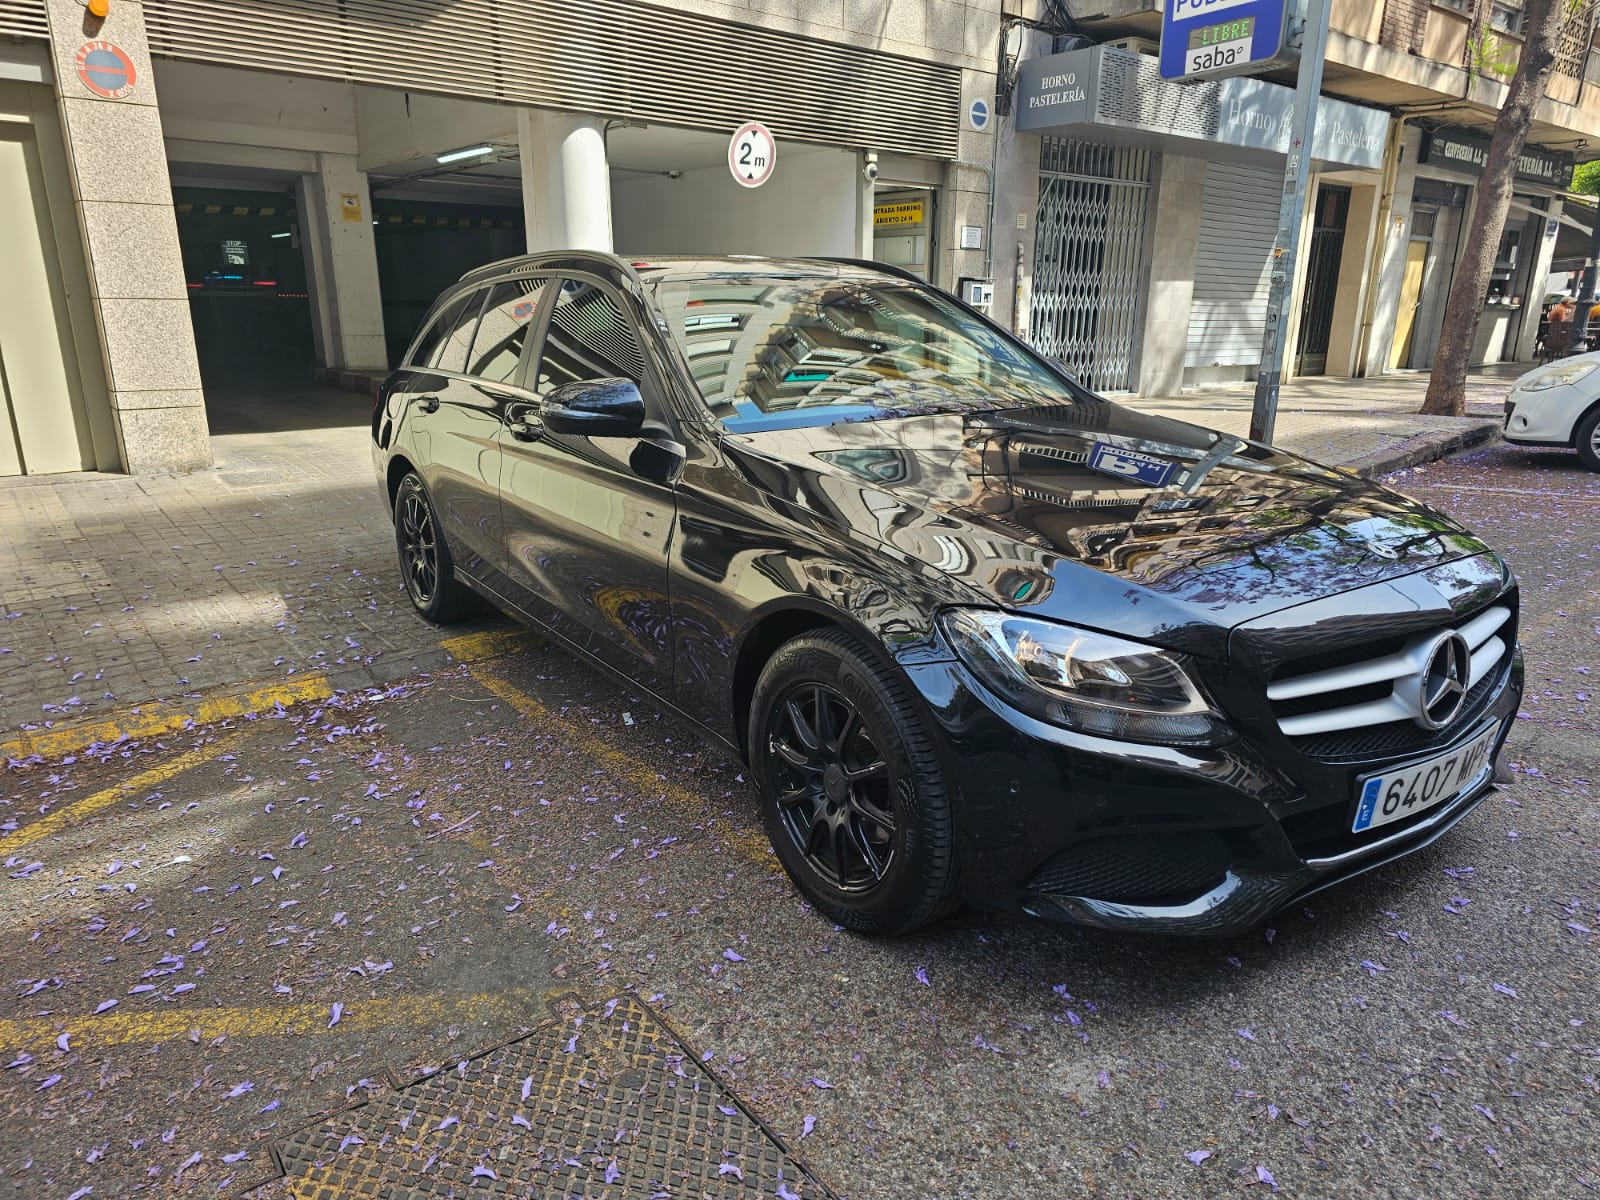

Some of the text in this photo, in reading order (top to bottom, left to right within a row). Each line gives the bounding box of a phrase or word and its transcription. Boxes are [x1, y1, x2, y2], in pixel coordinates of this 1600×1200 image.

[1201, 20, 1249, 45] LIBRE
[1041, 73, 1076, 89] HORNO
[1029, 86, 1085, 108] PASTELERÍA
[1229, 99, 1272, 130] Horno
[739, 142, 765, 168] 2 m
[1382, 757, 1459, 816] 6407
